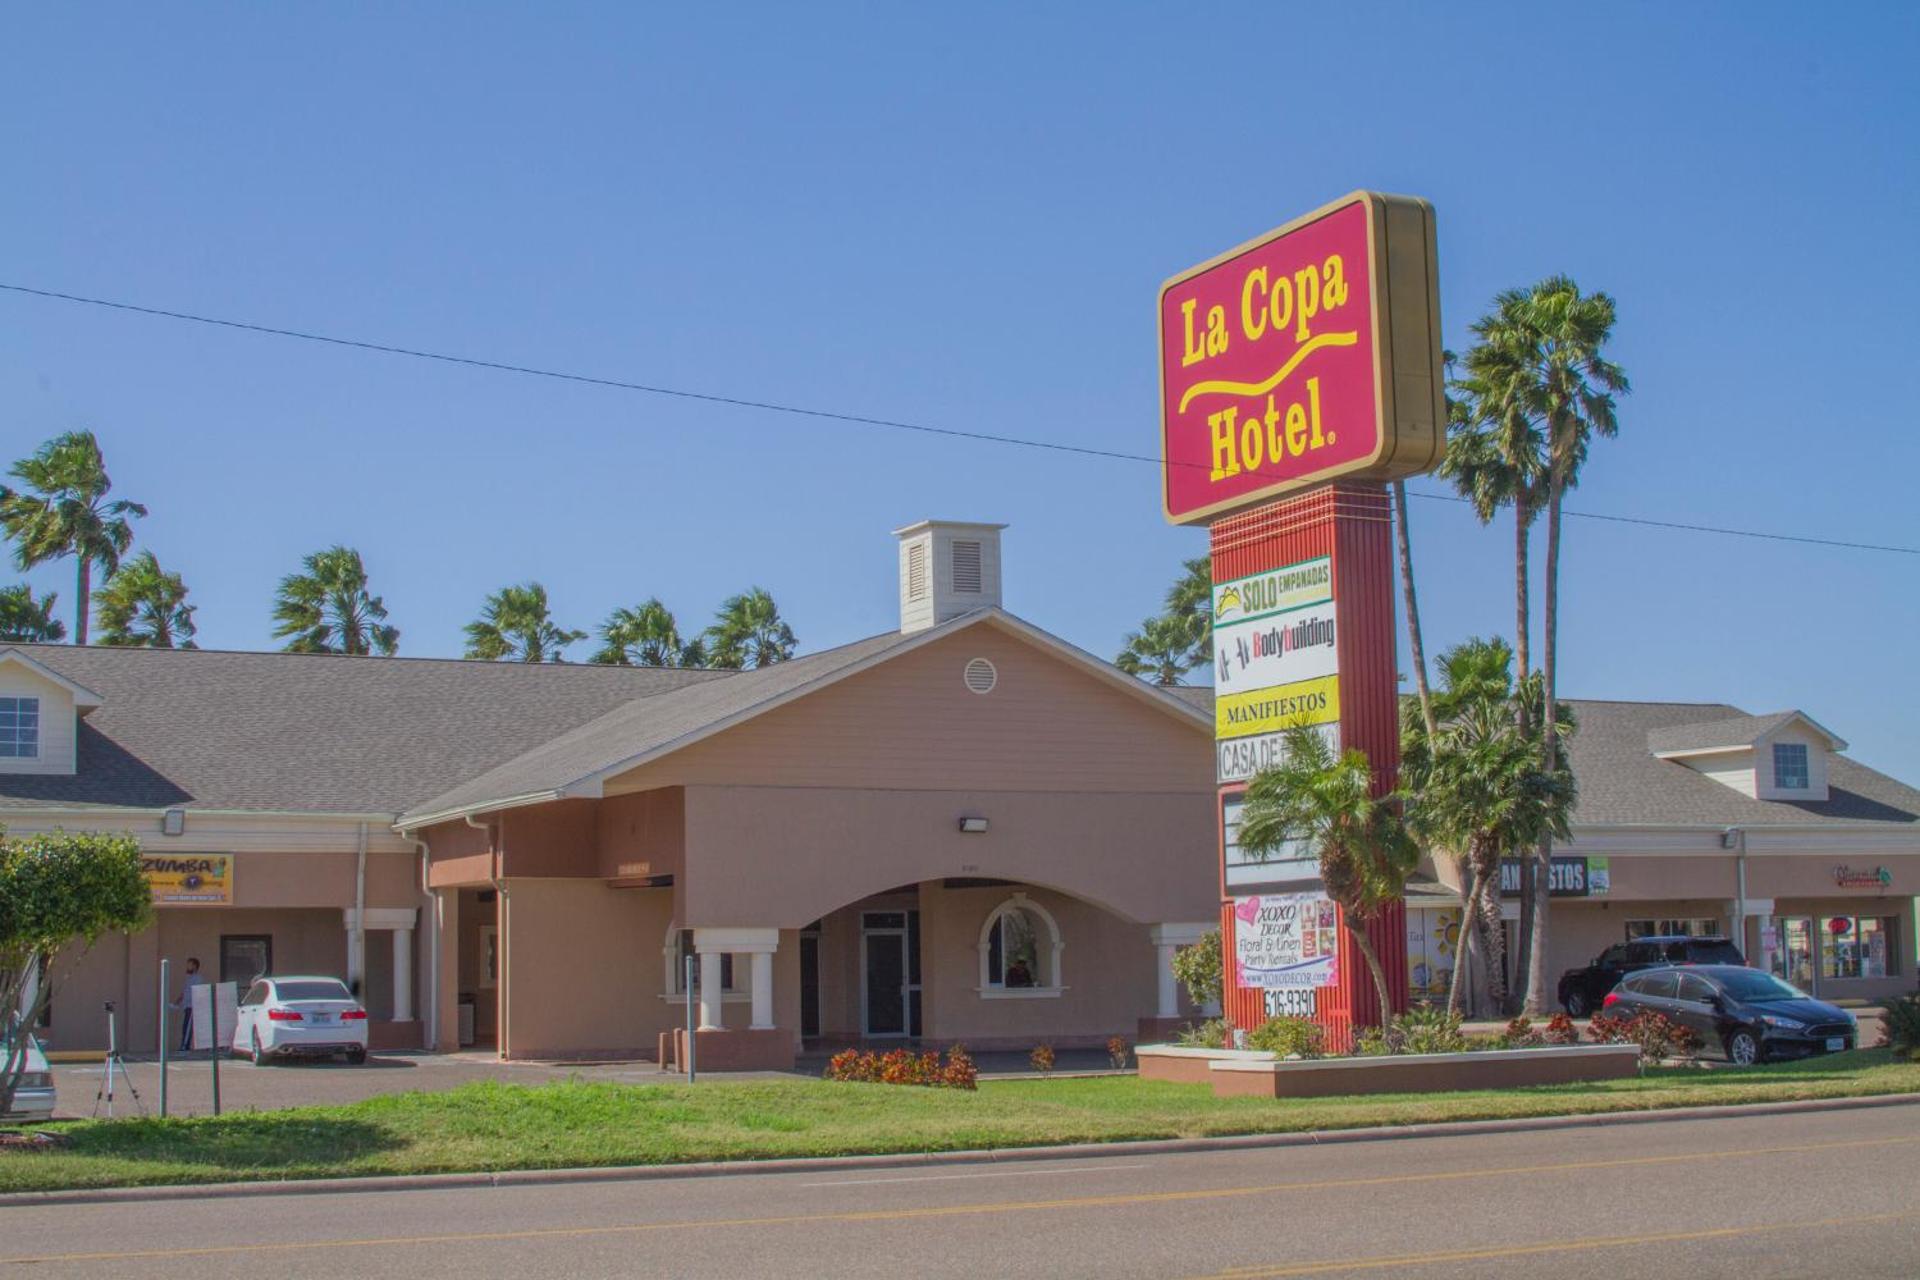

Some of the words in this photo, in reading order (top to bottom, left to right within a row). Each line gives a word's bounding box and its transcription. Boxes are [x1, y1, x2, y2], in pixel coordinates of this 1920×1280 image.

[1181, 298, 1229, 368] La
[1241, 254, 1348, 343] Copa
[1242, 576, 1277, 613] SOLO
[1279, 564, 1329, 593] EMPANADAS
[1253, 616, 1335, 659] Bodybuilding
[1227, 691, 1327, 724] MANIFIESTOS
[1222, 741, 1257, 776] CASA
[1260, 737, 1278, 771] DE
[143, 858, 212, 873] ZUMBA
[1257, 904, 1296, 923] XOXO
[1261, 923, 1293, 938] DECOR
